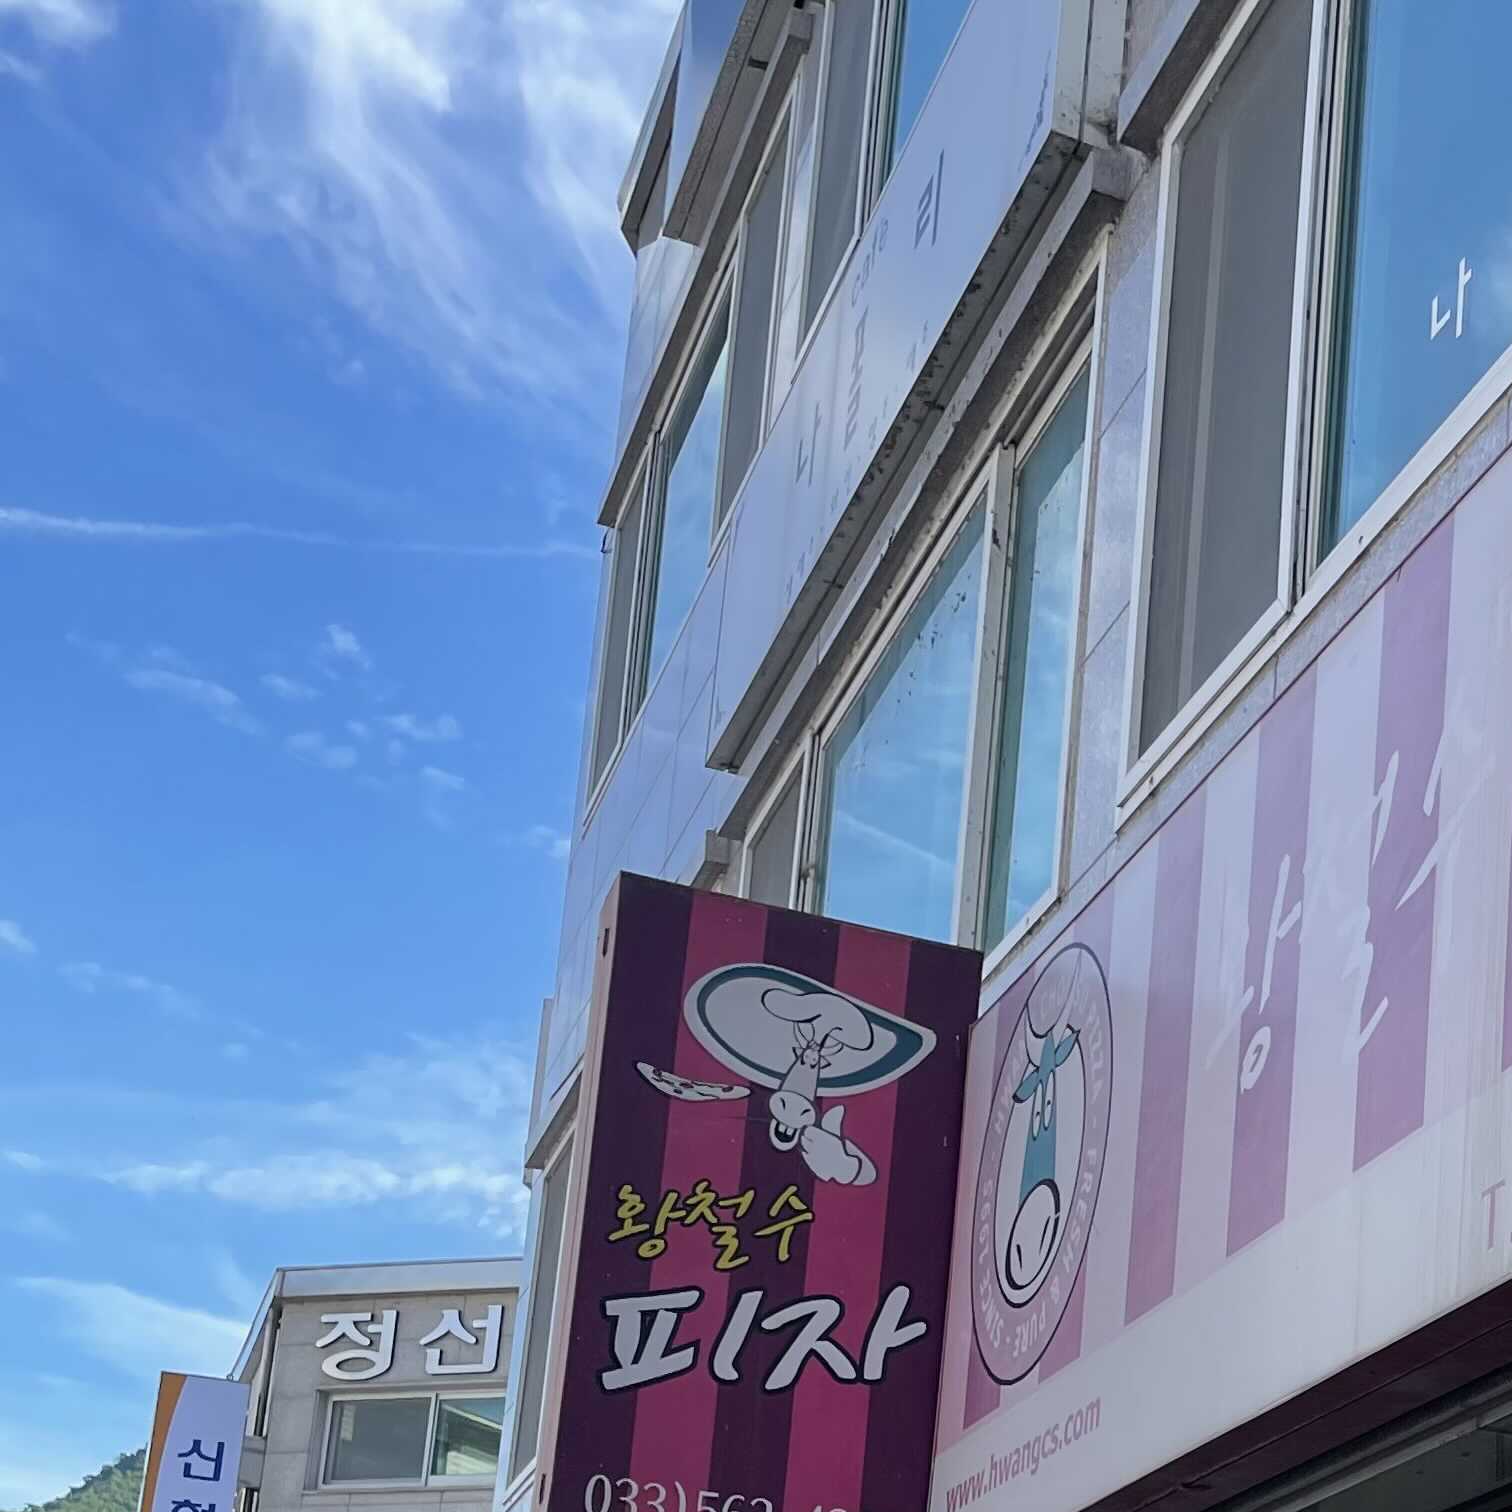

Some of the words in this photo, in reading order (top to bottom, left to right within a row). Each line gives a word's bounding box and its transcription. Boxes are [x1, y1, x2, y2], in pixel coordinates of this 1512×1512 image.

[607, 1182, 814, 1271] 황철수
[316, 1304, 505, 1381] 정선
[600, 1284, 928, 1392] 피자
